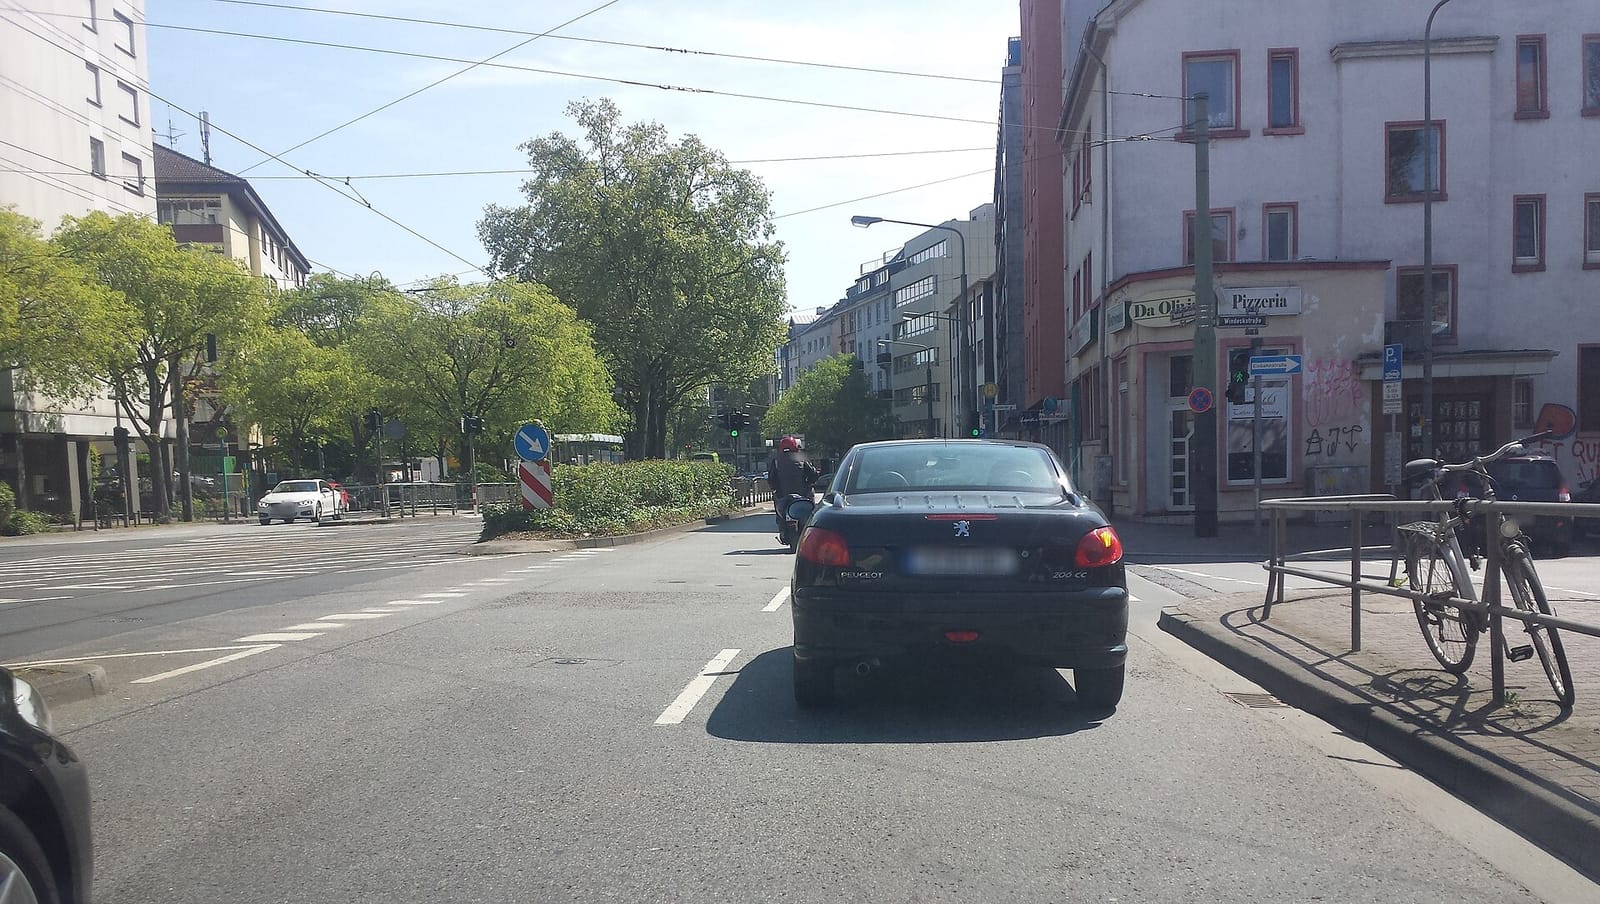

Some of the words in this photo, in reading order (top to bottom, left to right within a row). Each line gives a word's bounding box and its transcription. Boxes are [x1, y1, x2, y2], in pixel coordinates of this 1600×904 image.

[1232, 293, 1288, 310] Pizzeria
[1134, 303, 1155, 318] Da
[840, 571, 884, 579] PEUGEOT
